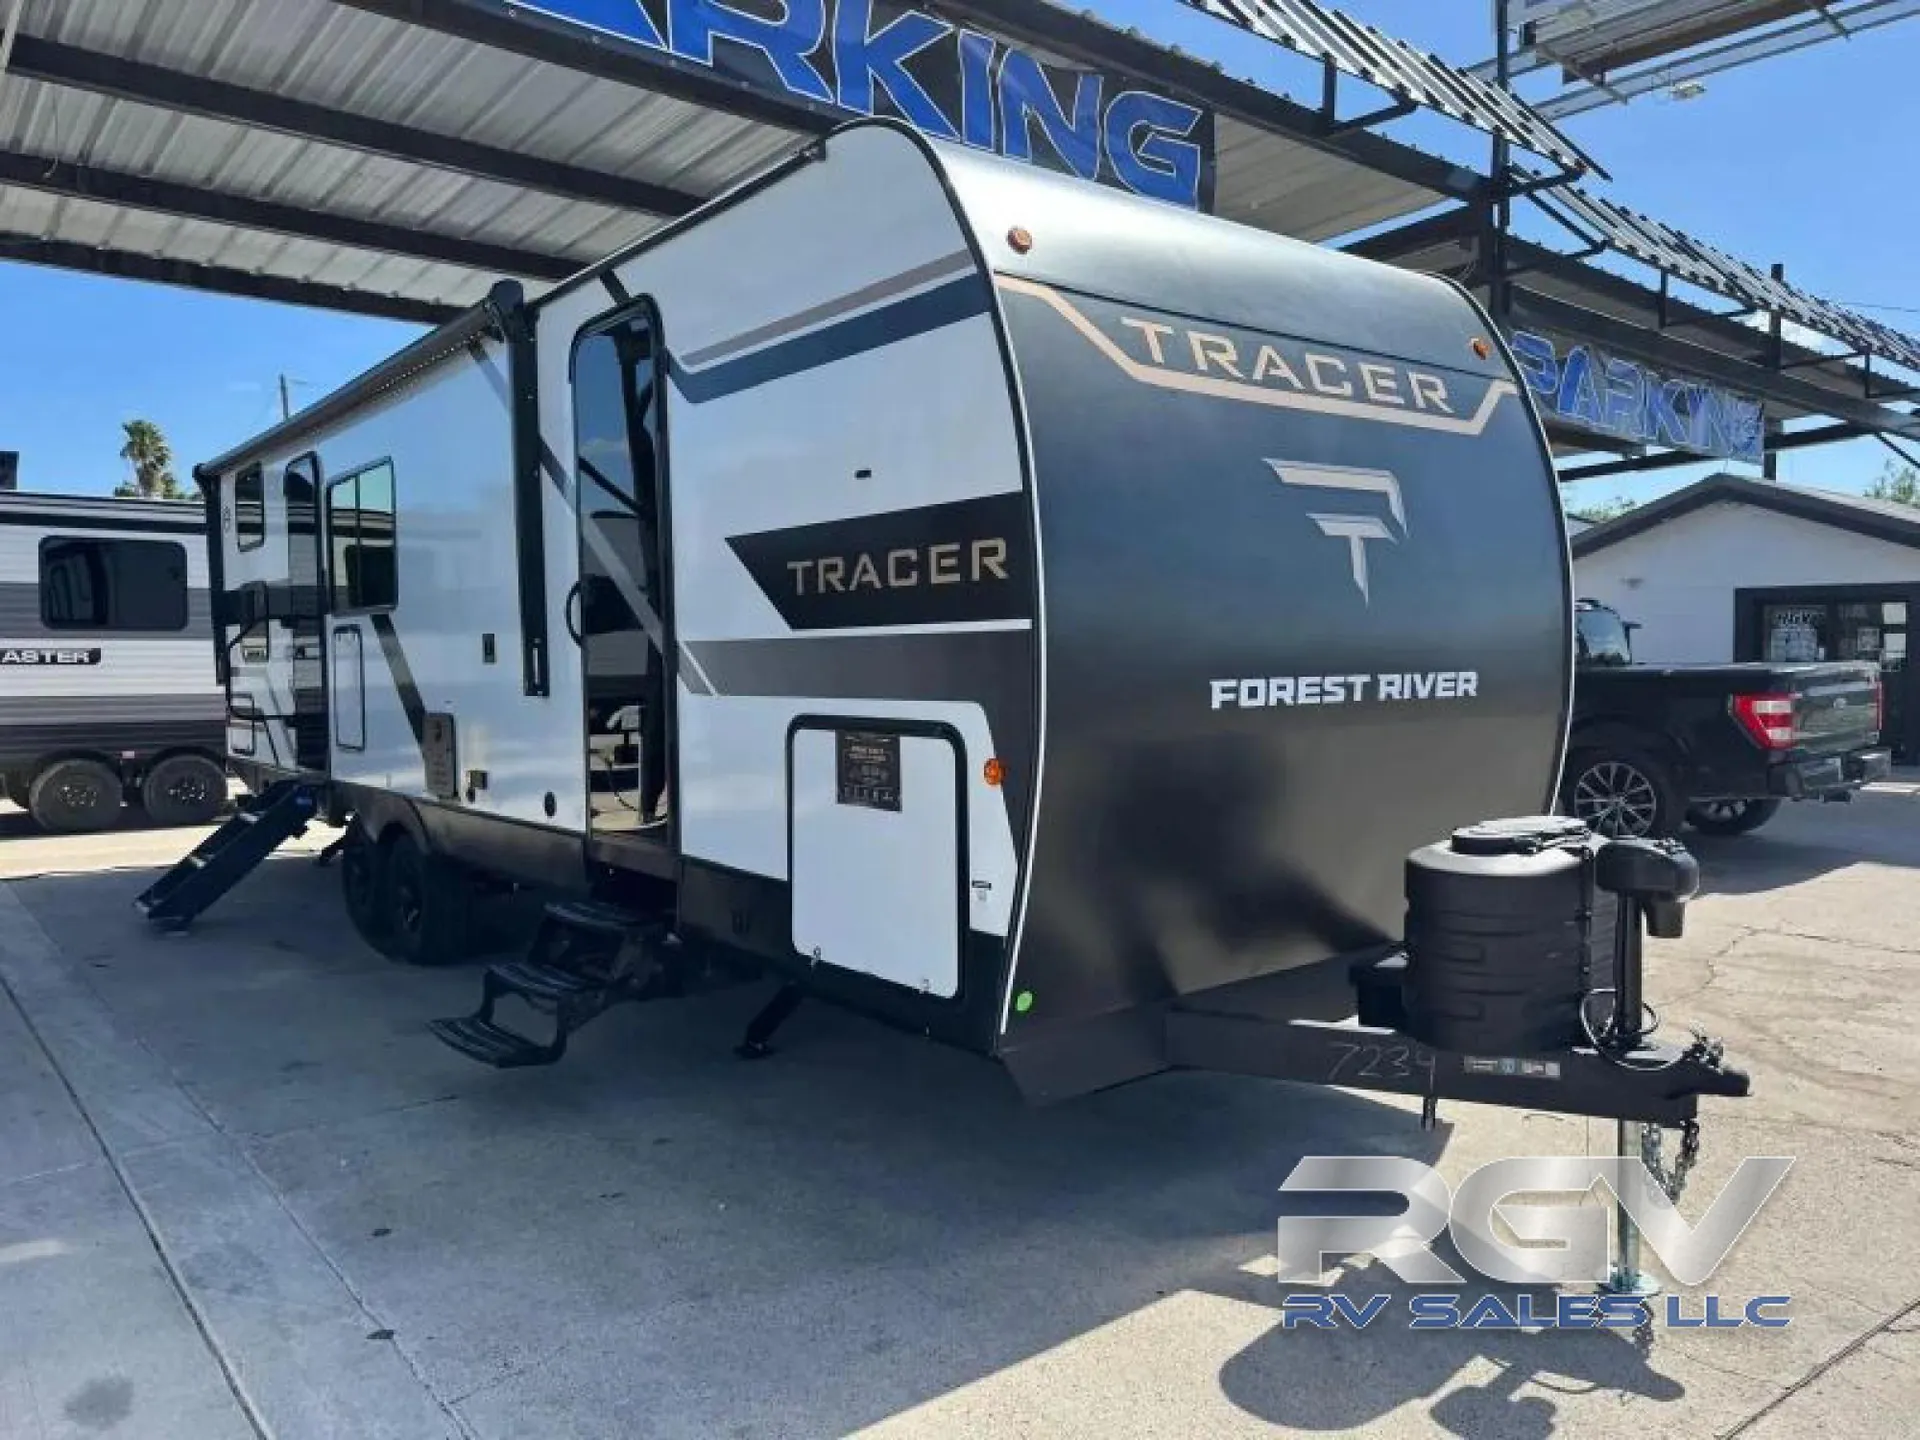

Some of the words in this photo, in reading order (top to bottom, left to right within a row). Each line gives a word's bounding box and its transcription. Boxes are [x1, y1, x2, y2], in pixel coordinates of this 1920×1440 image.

[505, 0, 1204, 208] RKING
[1121, 316, 1455, 415] TRACER
[786, 537, 1009, 596] TRACER
[1209, 674, 1371, 710] FOREST
[1377, 670, 1479, 701] RIVER
